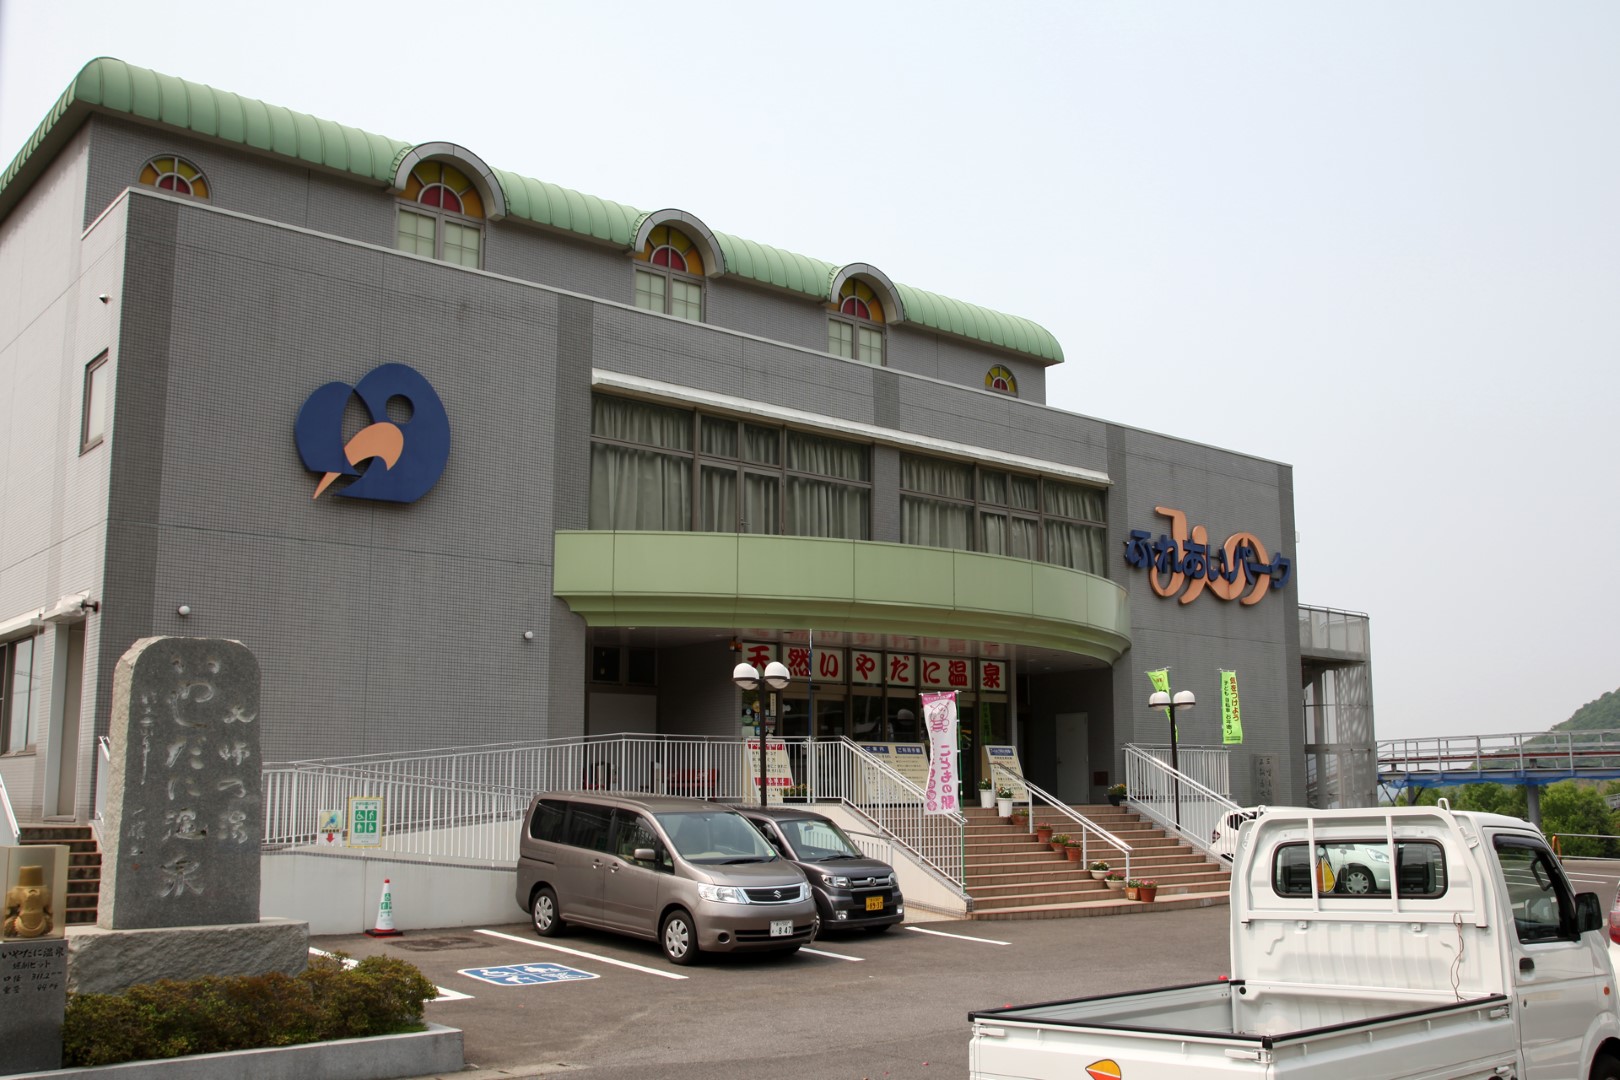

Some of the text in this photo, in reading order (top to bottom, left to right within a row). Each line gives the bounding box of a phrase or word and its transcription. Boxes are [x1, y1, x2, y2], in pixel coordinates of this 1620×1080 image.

[1125, 529, 1291, 589] ふれあいパーク
